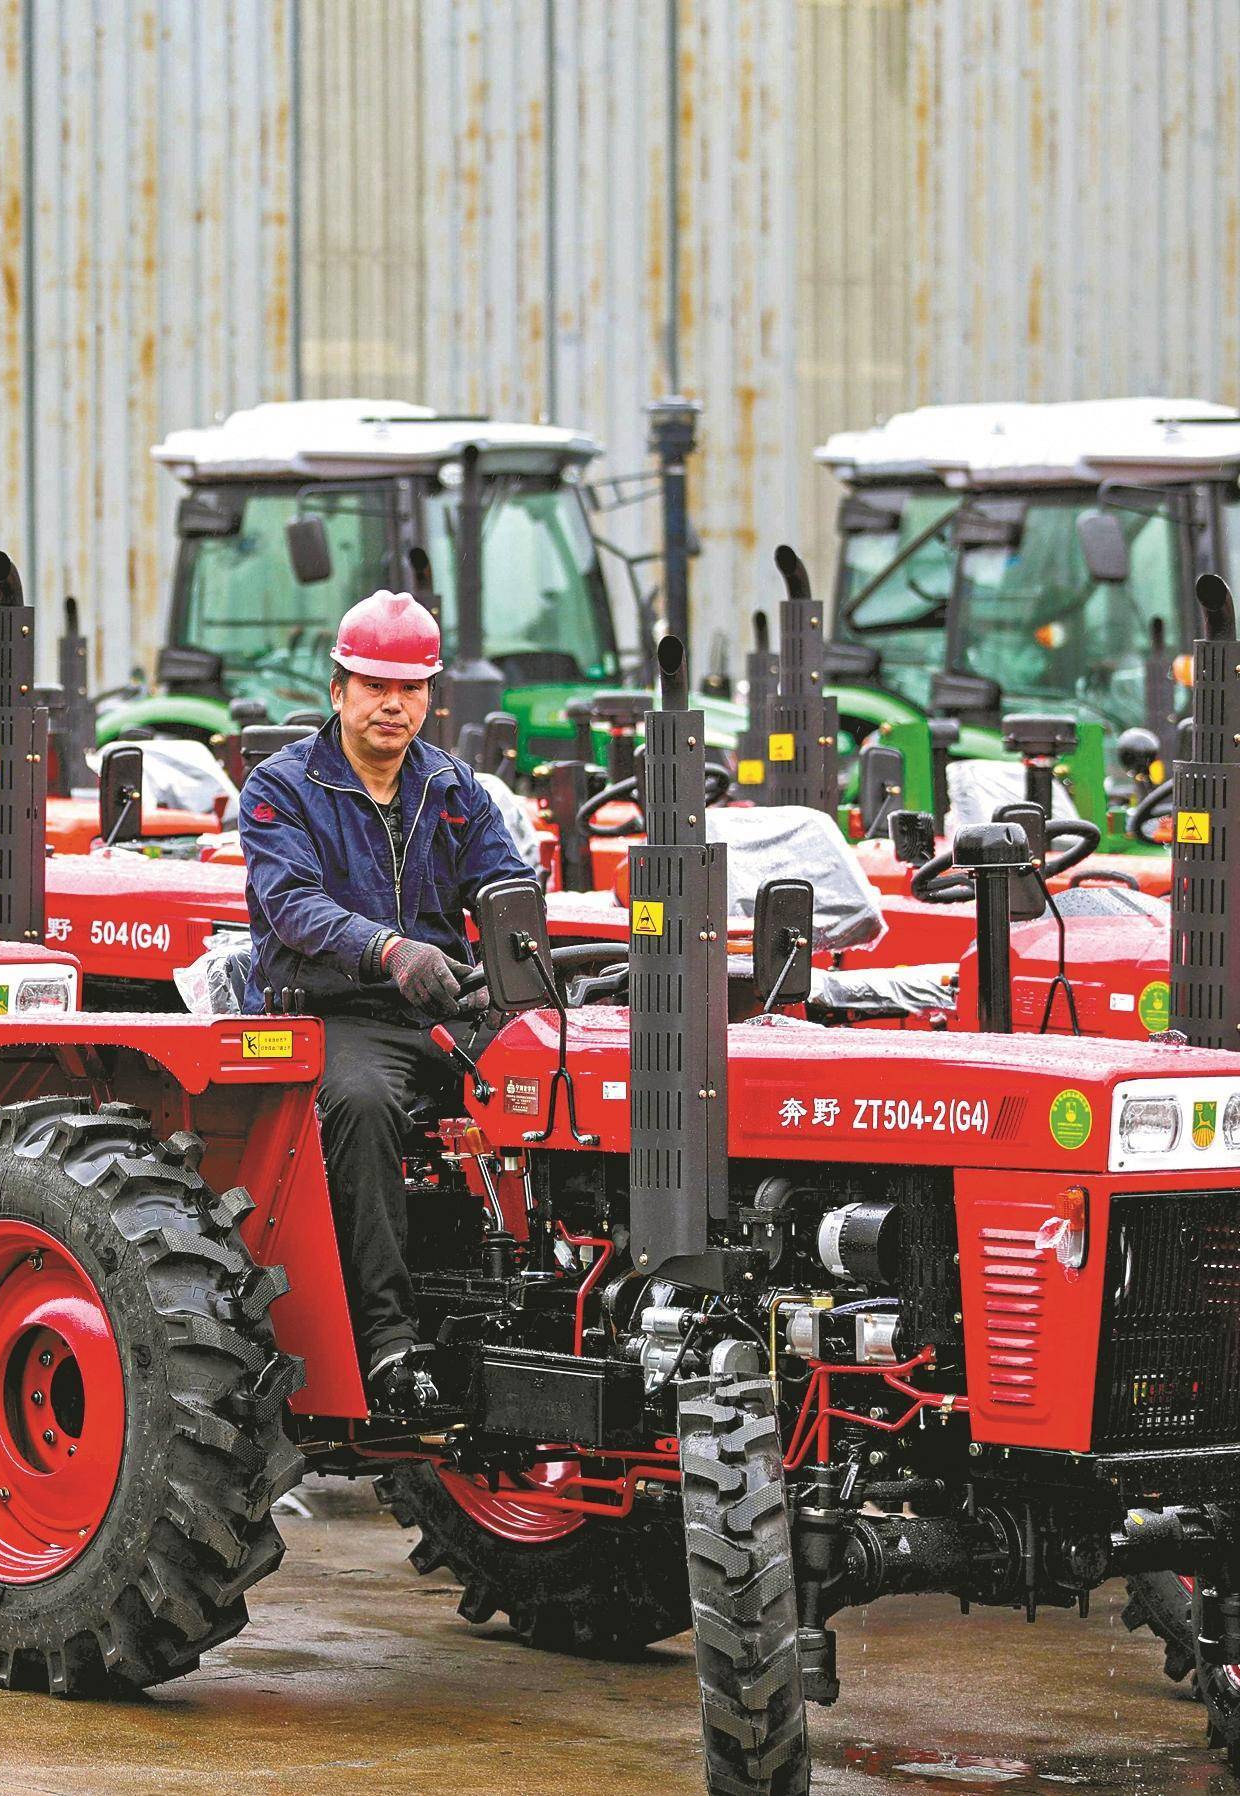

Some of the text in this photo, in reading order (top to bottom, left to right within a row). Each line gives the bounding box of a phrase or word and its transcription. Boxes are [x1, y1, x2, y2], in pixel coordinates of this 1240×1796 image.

[45, 917, 171, 952] 野 504(G4)
[778, 1097, 989, 1135] 奔野 ZT504-2(G4)
